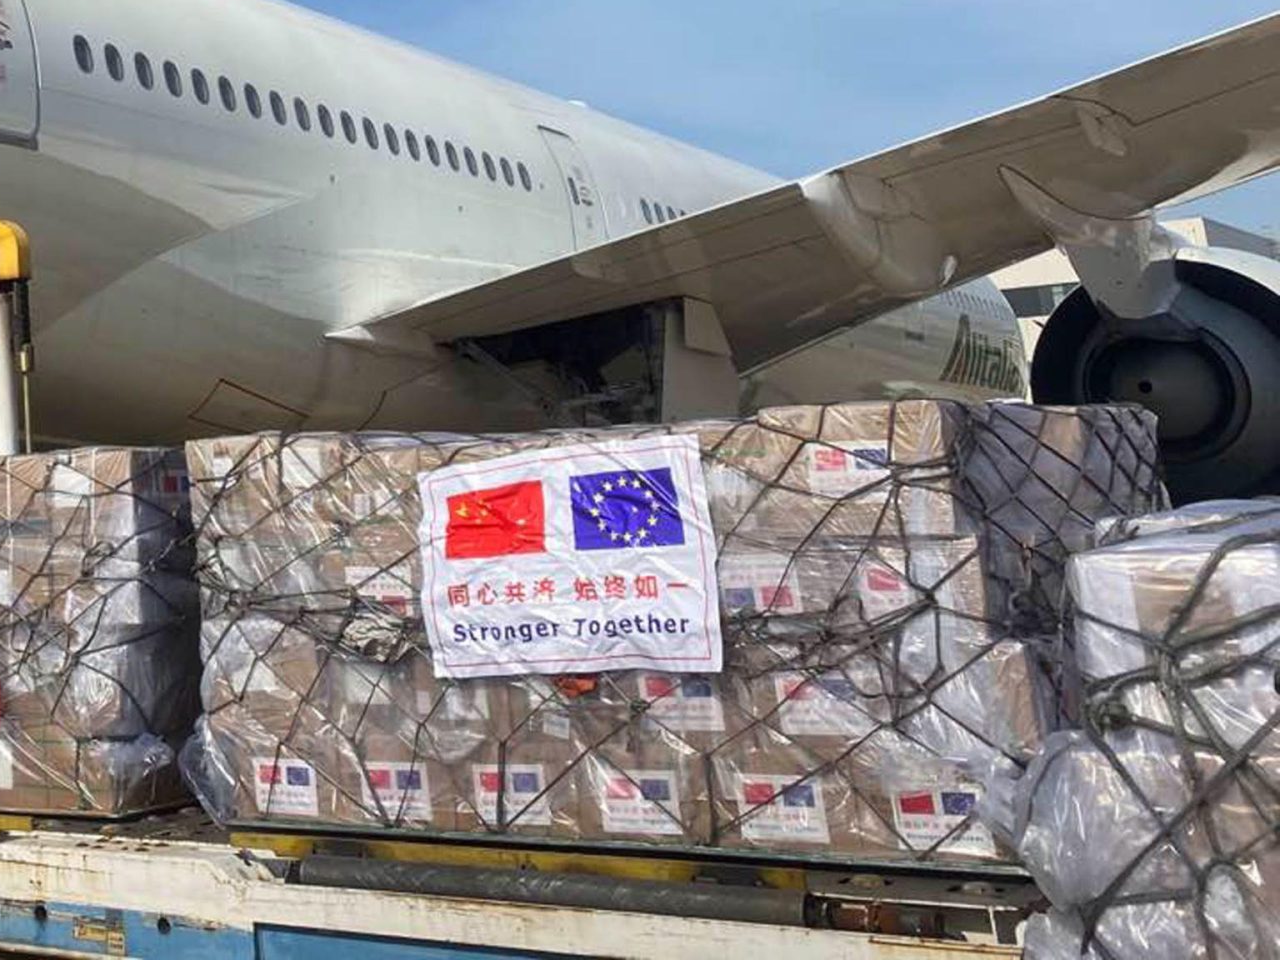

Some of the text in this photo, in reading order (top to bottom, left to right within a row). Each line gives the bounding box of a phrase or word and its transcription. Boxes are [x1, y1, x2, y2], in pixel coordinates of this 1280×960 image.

[447, 575, 688, 608] 同心共济 始终如一
[453, 614, 690, 643] Stronger Together
